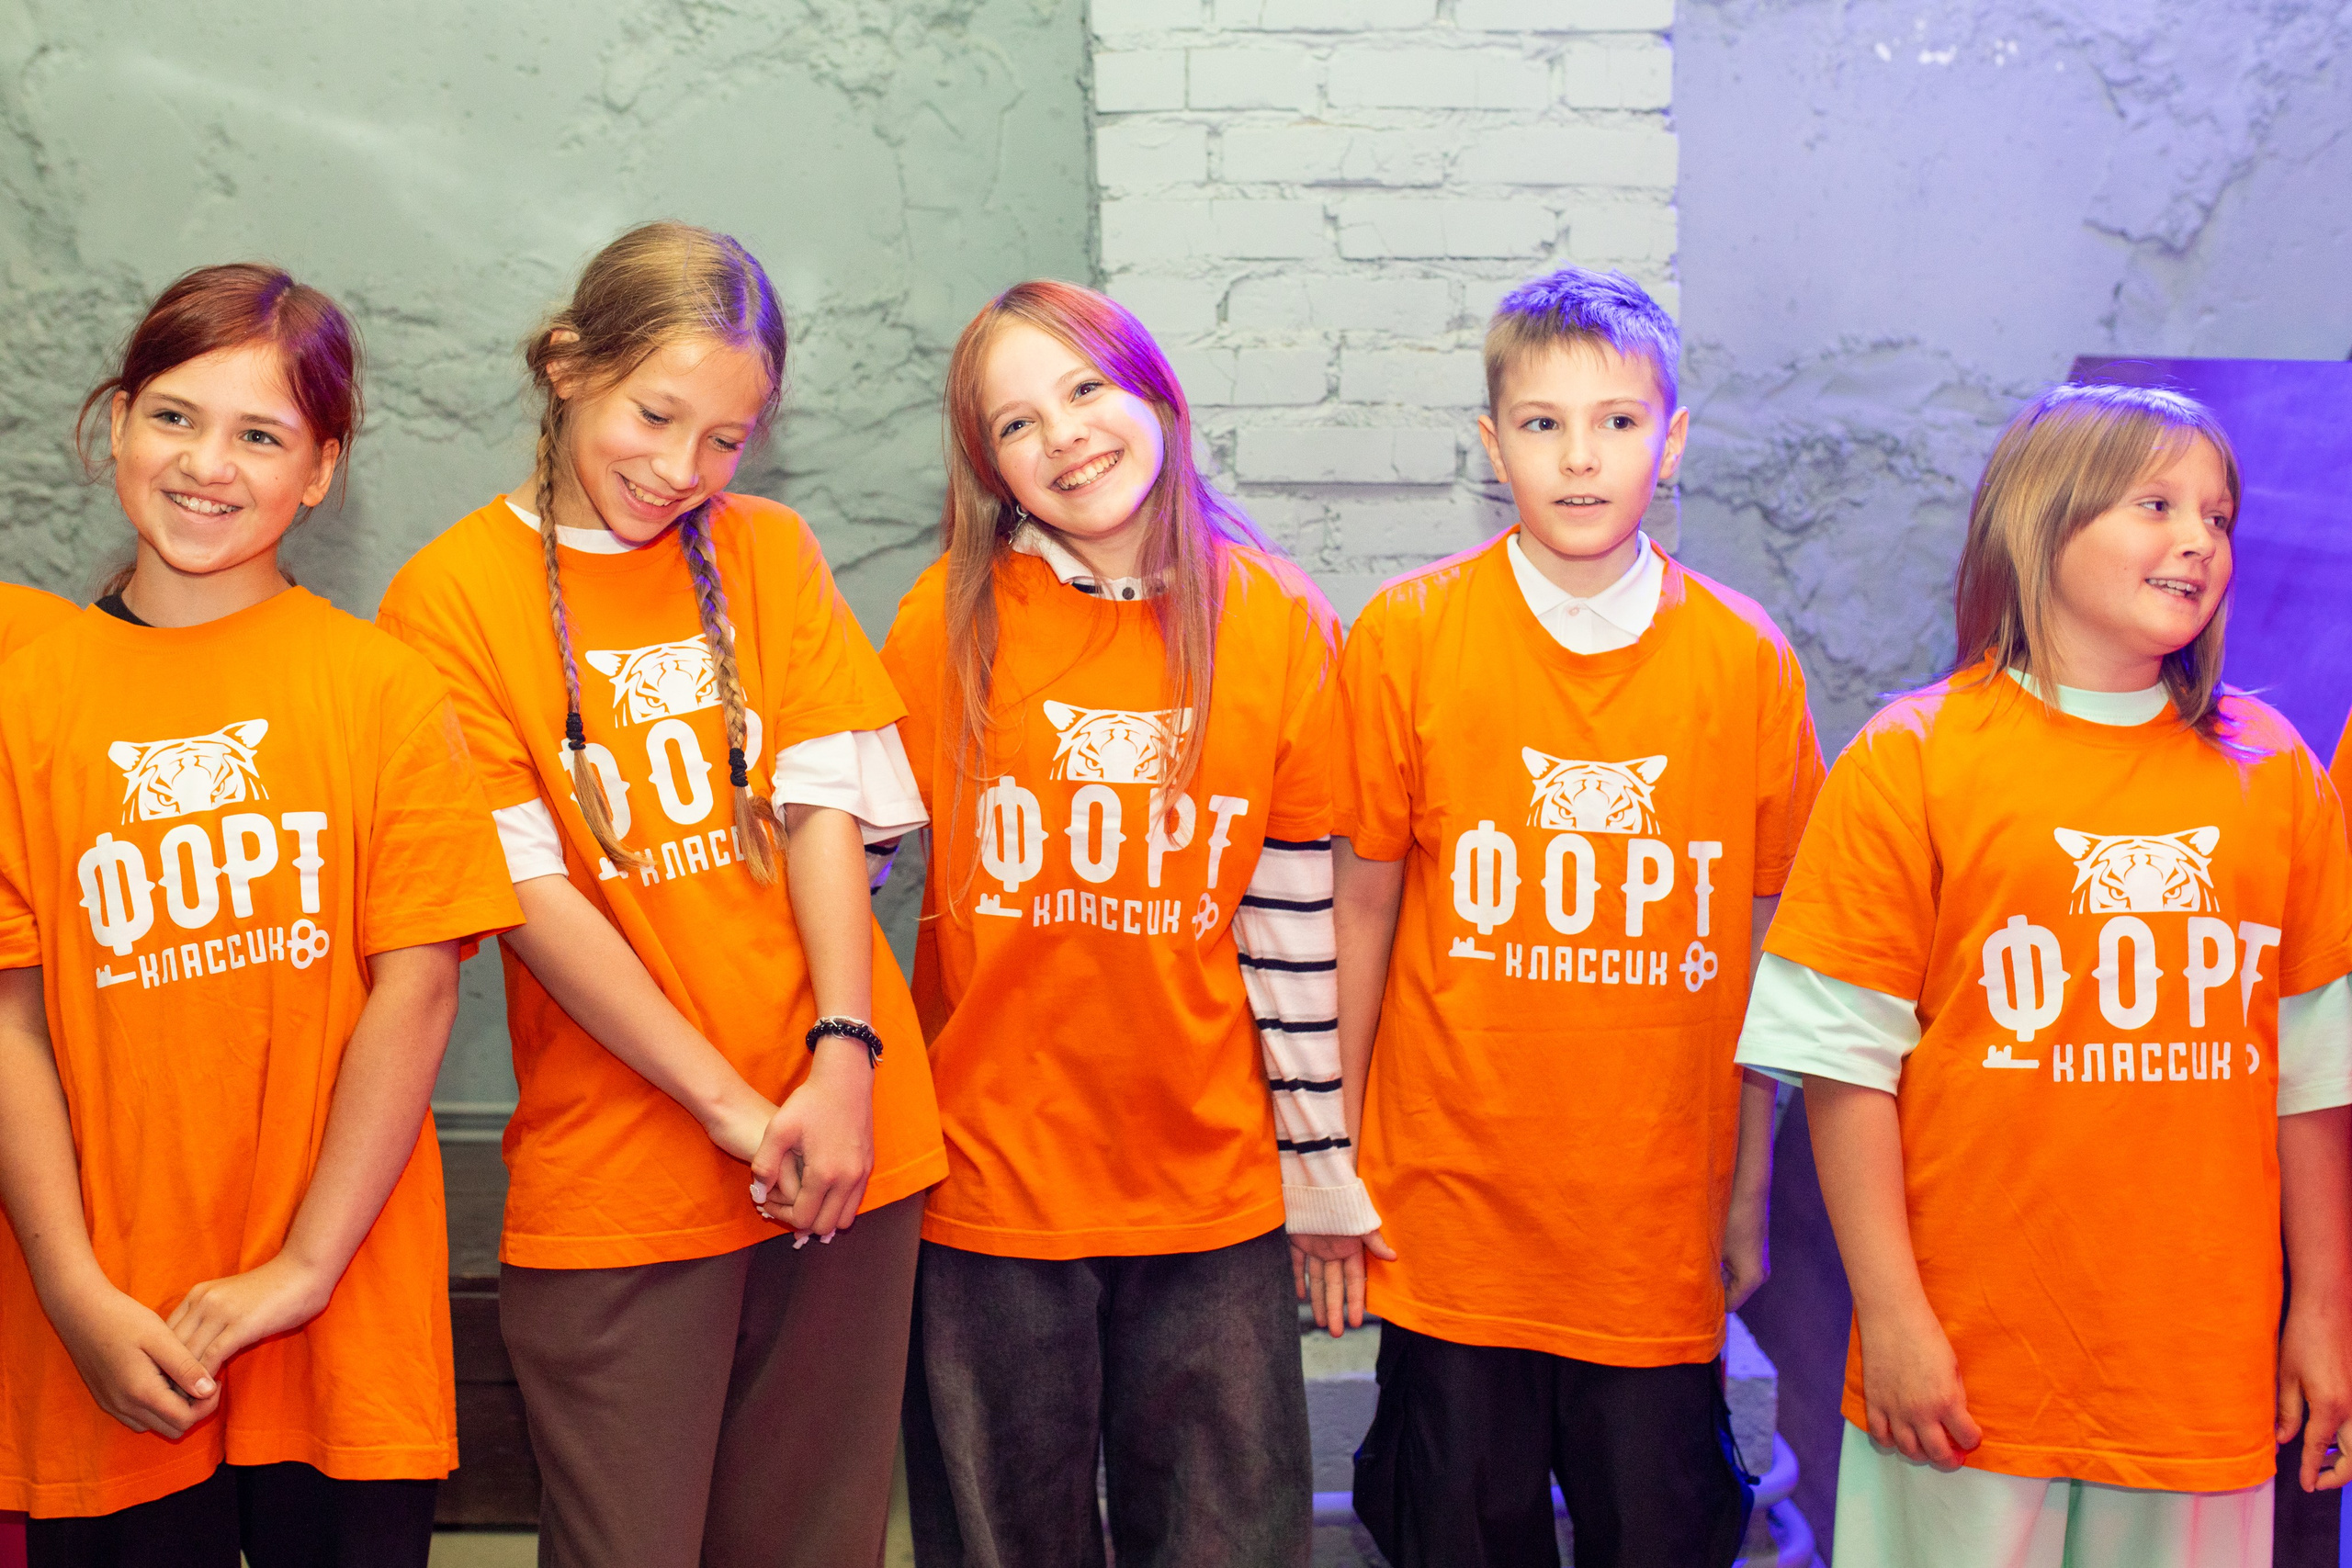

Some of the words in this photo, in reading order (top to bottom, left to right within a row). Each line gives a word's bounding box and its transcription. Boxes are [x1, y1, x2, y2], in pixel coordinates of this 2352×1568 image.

[976, 775, 1250, 893] ФОРТ
[1450, 819, 1723, 938] ФОРТ
[77, 811, 328, 956] ФОРТ
[1033, 888, 1182, 936] КЛАССИК
[138, 926, 285, 989] КЛАССИК
[1505, 942, 1668, 986] КЛАССИК
[1977, 914, 2282, 1043] ФОРТ
[2052, 1041, 2232, 1082] КЛАССИК
